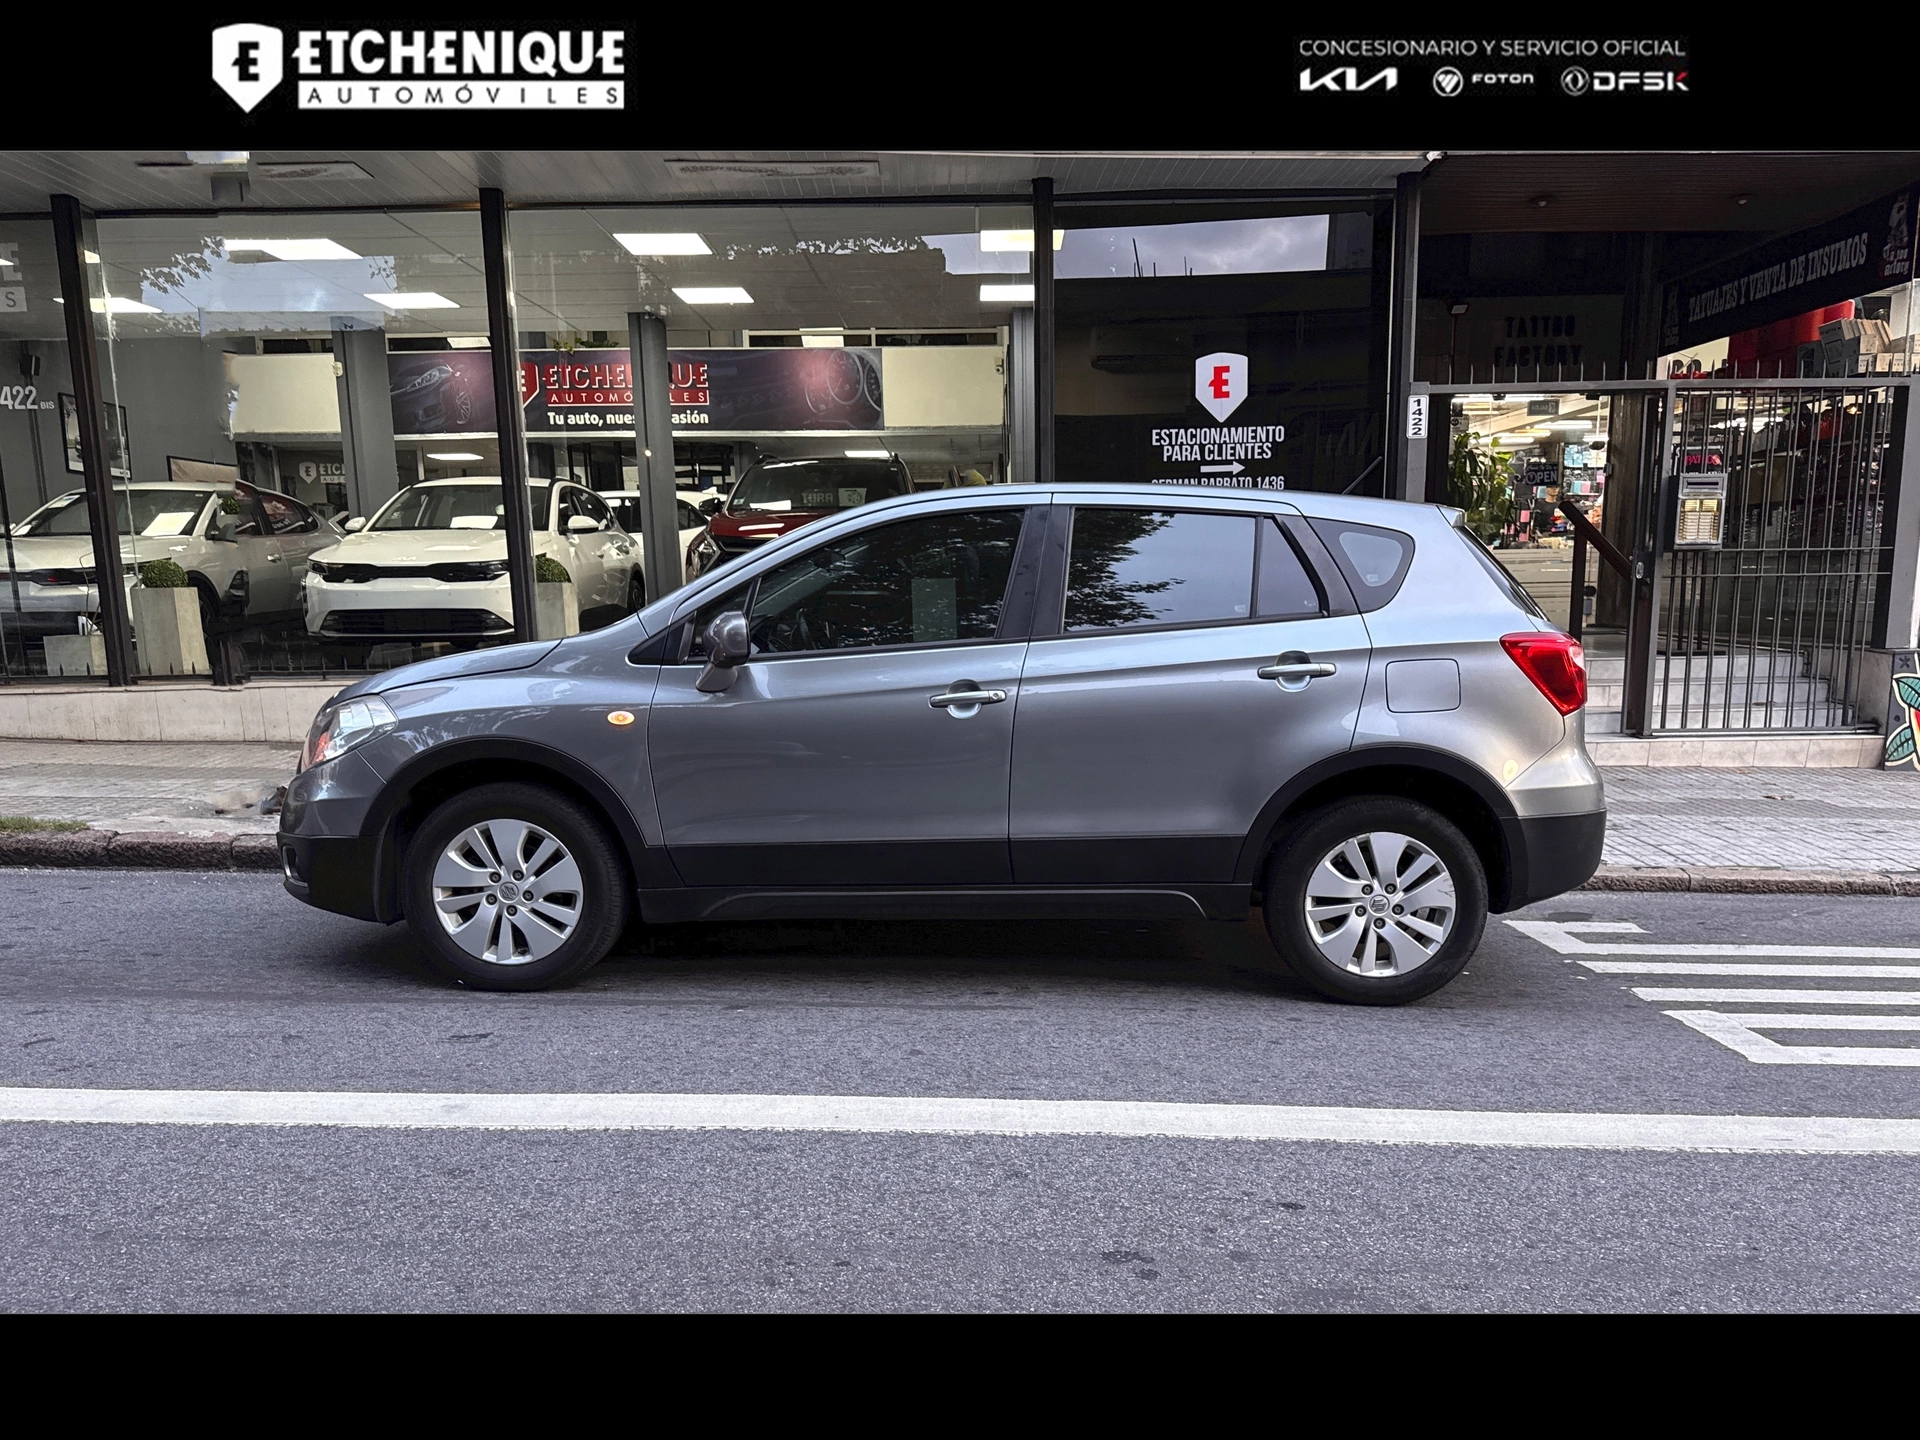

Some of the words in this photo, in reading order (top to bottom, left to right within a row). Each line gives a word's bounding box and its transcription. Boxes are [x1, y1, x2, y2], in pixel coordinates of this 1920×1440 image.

[1688, 279, 1739, 323] TATUAJES
[1739, 280, 1747, 304] Y
[1749, 263, 1787, 301] VENTA
[1788, 254, 1806, 288] DE
[1806, 232, 1869, 281] INSUMOS
[1504, 315, 1576, 338] TATTOO
[1494, 344, 1583, 367] FACTORY
[0, 386, 39, 411] 422
[40, 401, 55, 410] BIS
[547, 412, 564, 425] Tu
[567, 412, 604, 427] auto,
[1411, 398, 1424, 436] 1422
[1152, 426, 1285, 446] ESTACIONAMIENTO
[1163, 445, 1201, 462] PARA
[1204, 442, 1272, 461] CLIENTES
[1256, 476, 1285, 490] 1436
[1525, 470, 1557, 485] OPEN
